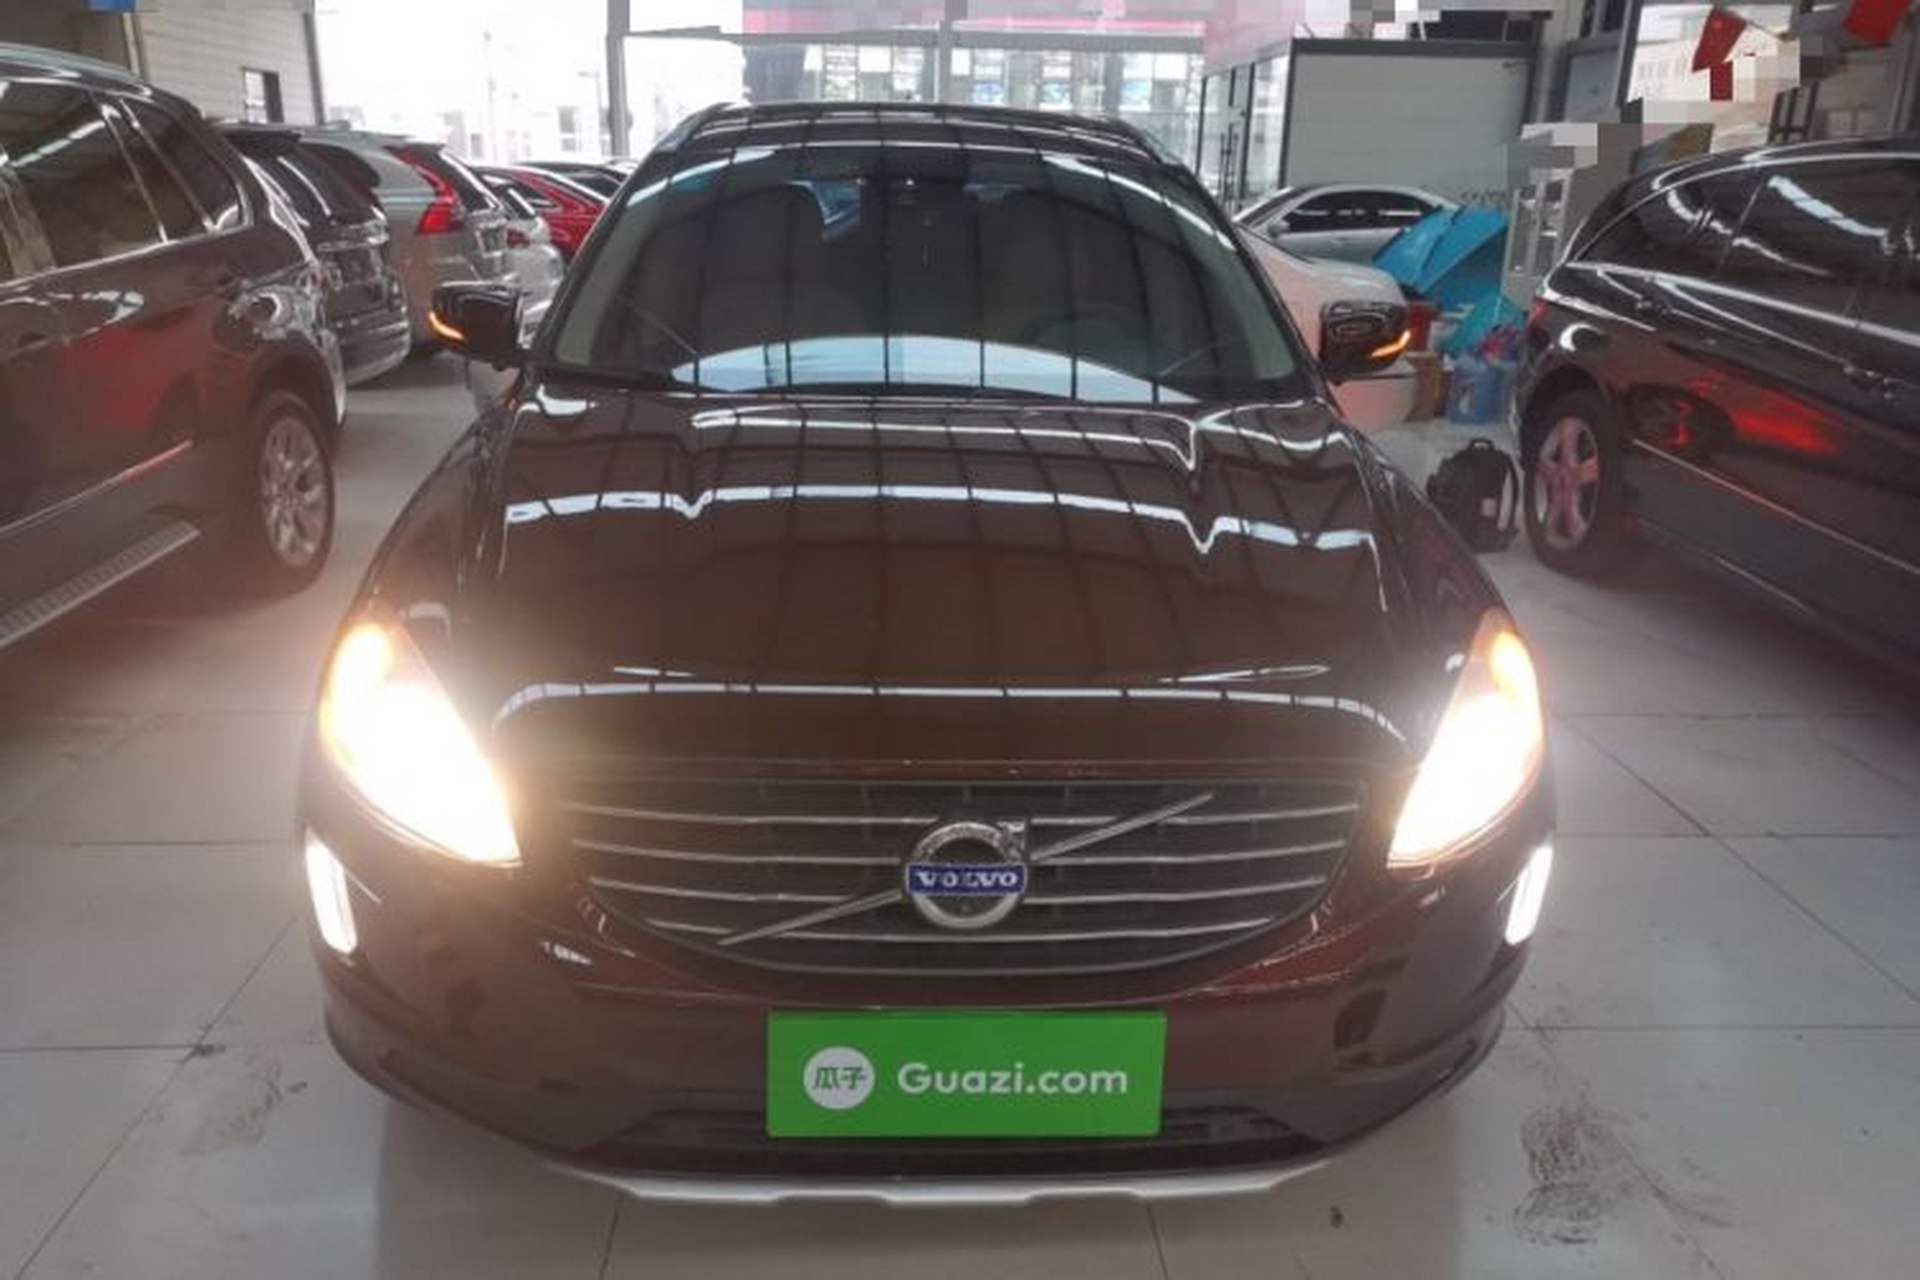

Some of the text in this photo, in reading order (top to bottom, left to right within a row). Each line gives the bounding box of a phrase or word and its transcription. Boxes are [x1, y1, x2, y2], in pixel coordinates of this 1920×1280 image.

[914, 870, 1019, 888] VOLVO
[811, 1065, 867, 1090] 瓜子
[897, 1061, 1128, 1094] Guazi.com
